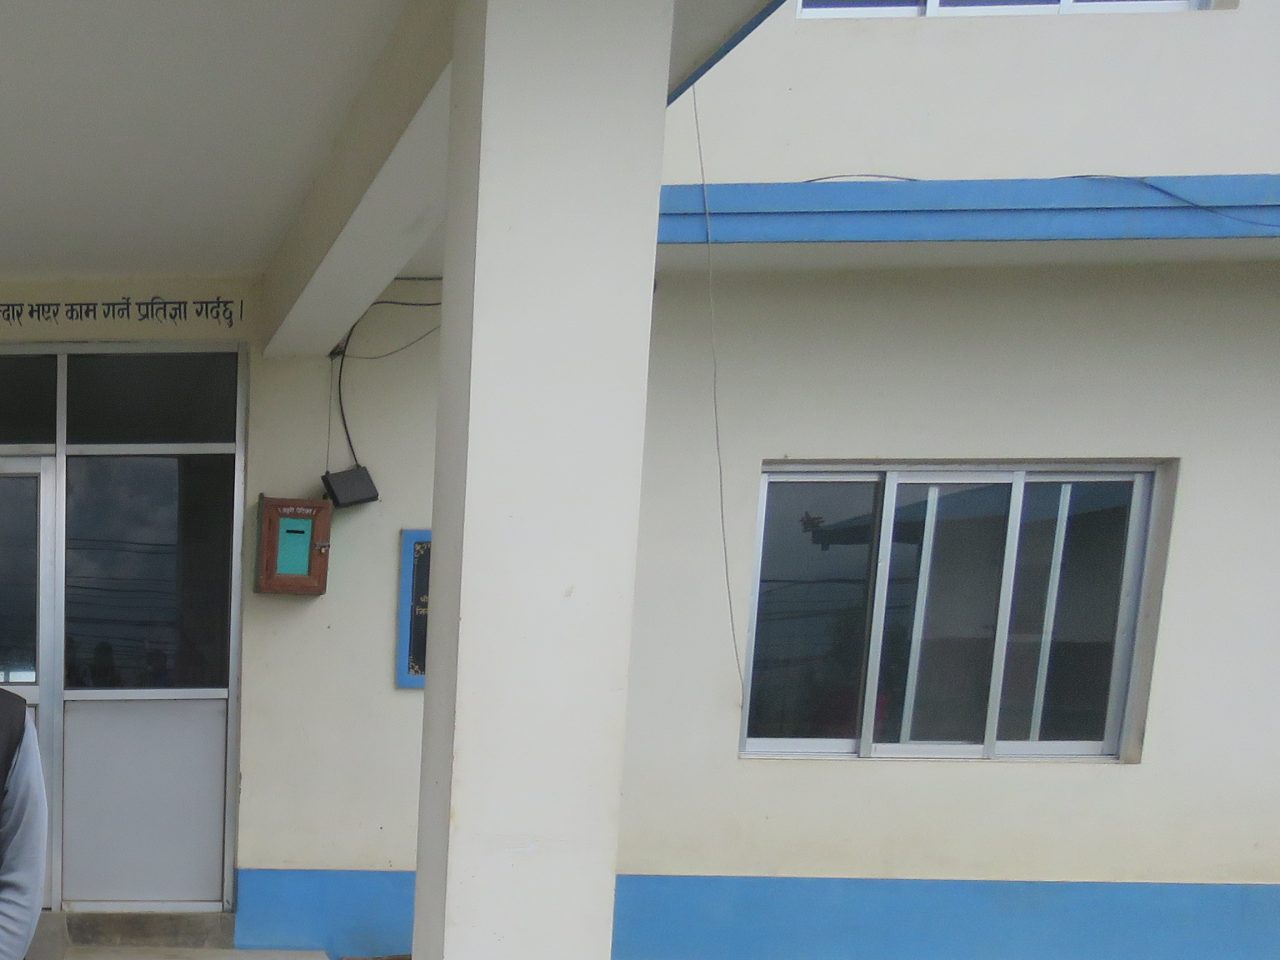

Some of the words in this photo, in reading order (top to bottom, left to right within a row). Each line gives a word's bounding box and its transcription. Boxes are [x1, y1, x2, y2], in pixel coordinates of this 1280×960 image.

[28, 302, 61, 326] भएर
[65, 303, 98, 321] काम
[102, 297, 132, 321] गर्ने
[136, 297, 188, 326] प्रतिज्ञा
